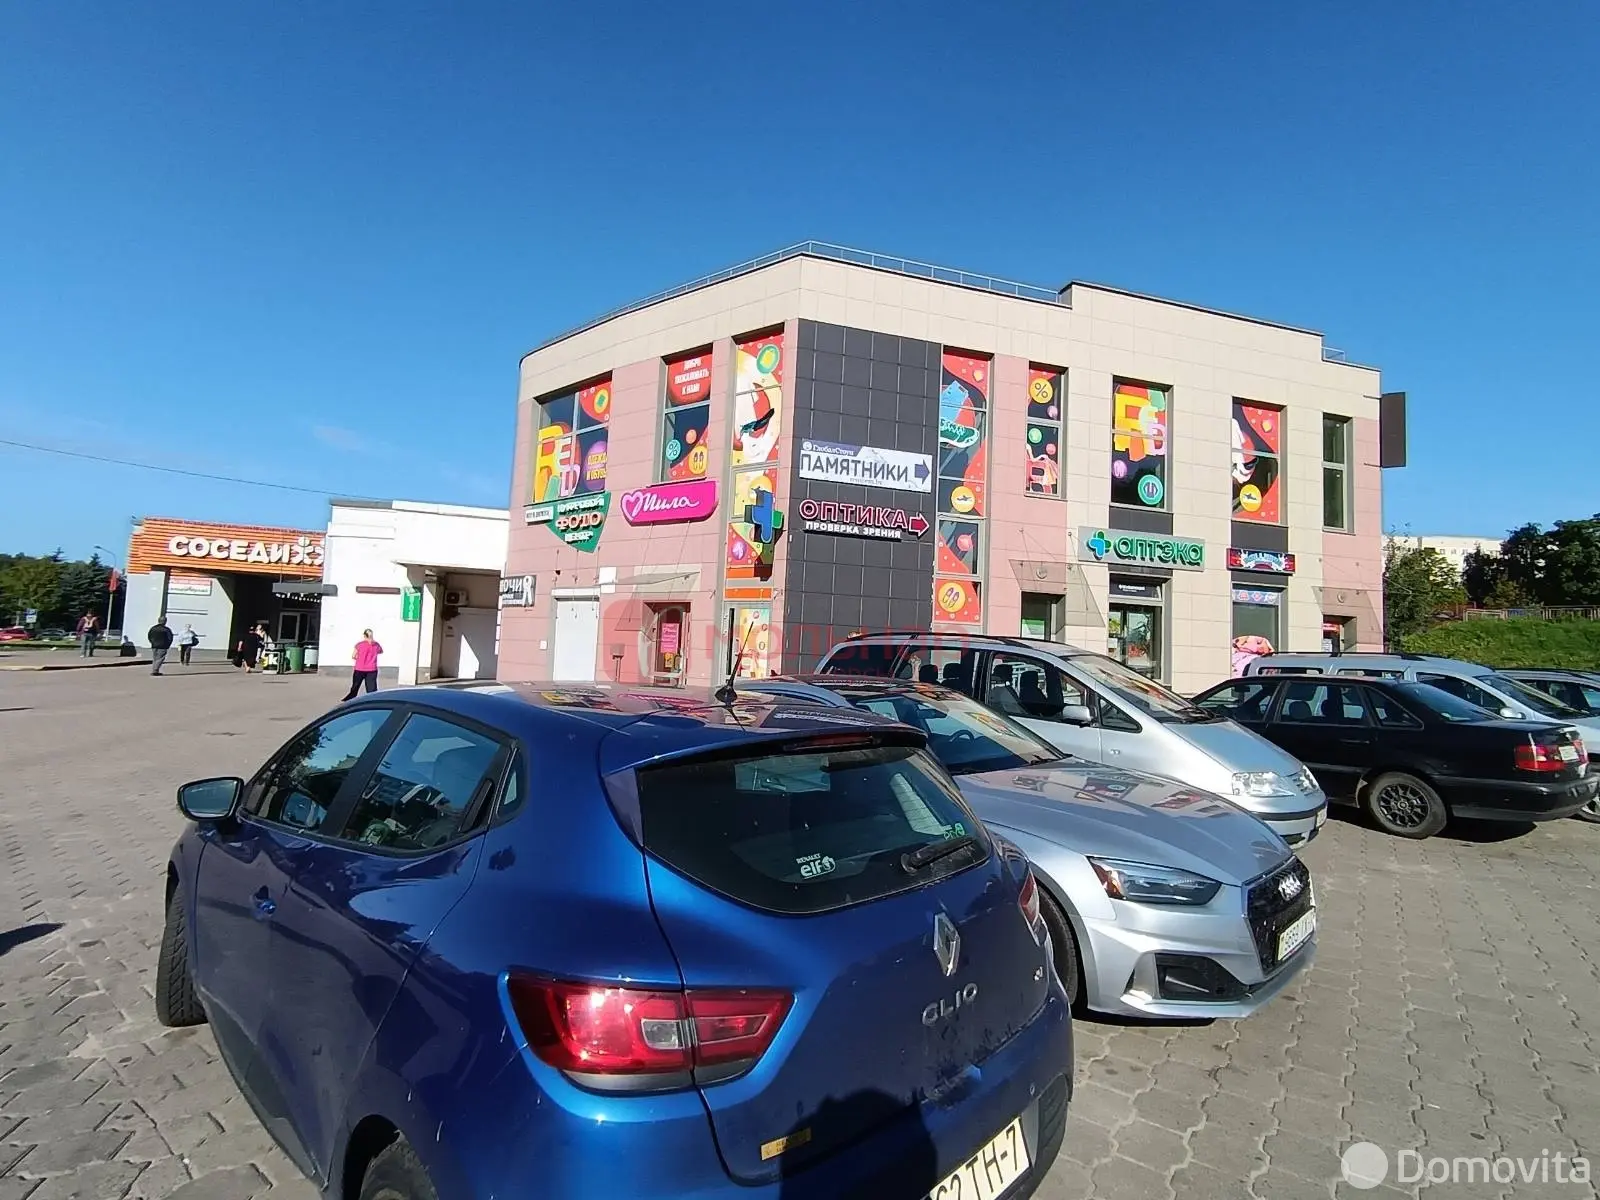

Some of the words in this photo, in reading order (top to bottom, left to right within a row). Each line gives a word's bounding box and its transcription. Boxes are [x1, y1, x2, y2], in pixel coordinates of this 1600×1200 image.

[801, 453, 908, 482] ПАМЯТНИКИ
[638, 491, 700, 513] Мила
[799, 499, 908, 529] ОПТИКА
[555, 512, 602, 530] ФОТО
[805, 521, 859, 535] ПРОВЕРКА
[863, 527, 901, 539] ЗРЕНИЯ
[168, 535, 290, 564] СОСЕДИ
[1116, 537, 1203, 564] аптэка
[800, 859, 822, 877] elf
[922, 983, 978, 1027] CLIO
